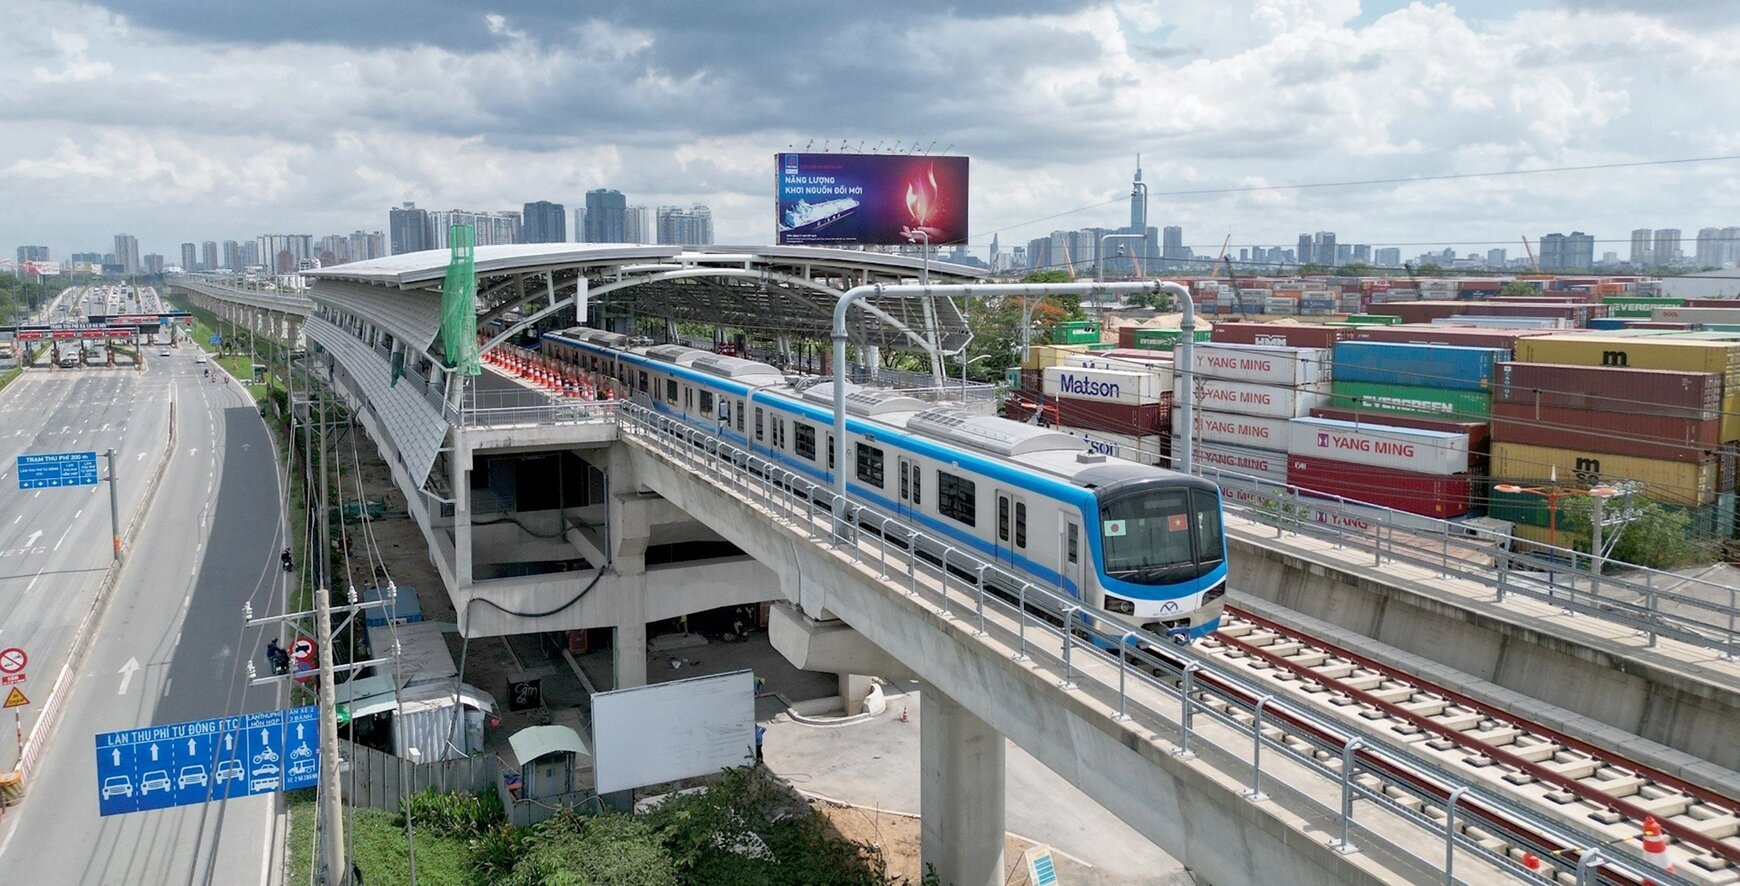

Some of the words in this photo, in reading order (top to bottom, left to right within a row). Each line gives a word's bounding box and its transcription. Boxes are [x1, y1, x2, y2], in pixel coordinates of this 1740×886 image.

[1207, 356, 1237, 369] YANG
[1240, 359, 1271, 371] MING
[1061, 374, 1119, 398] Matson
[1207, 389, 1236, 401] YANG
[1240, 392, 1271, 405] MING
[1362, 395, 1454, 413] EVERGREEN
[1206, 420, 1235, 434] YANG
[1238, 425, 1269, 438] MING
[1332, 436, 1370, 452] YANG
[1374, 441, 1414, 458] MING
[1205, 452, 1234, 466] YANG
[1237, 457, 1269, 471] MING
[108, 732, 129, 746] LÀN
[131, 730, 152, 743] THU
[153, 725, 170, 740] PHÍ
